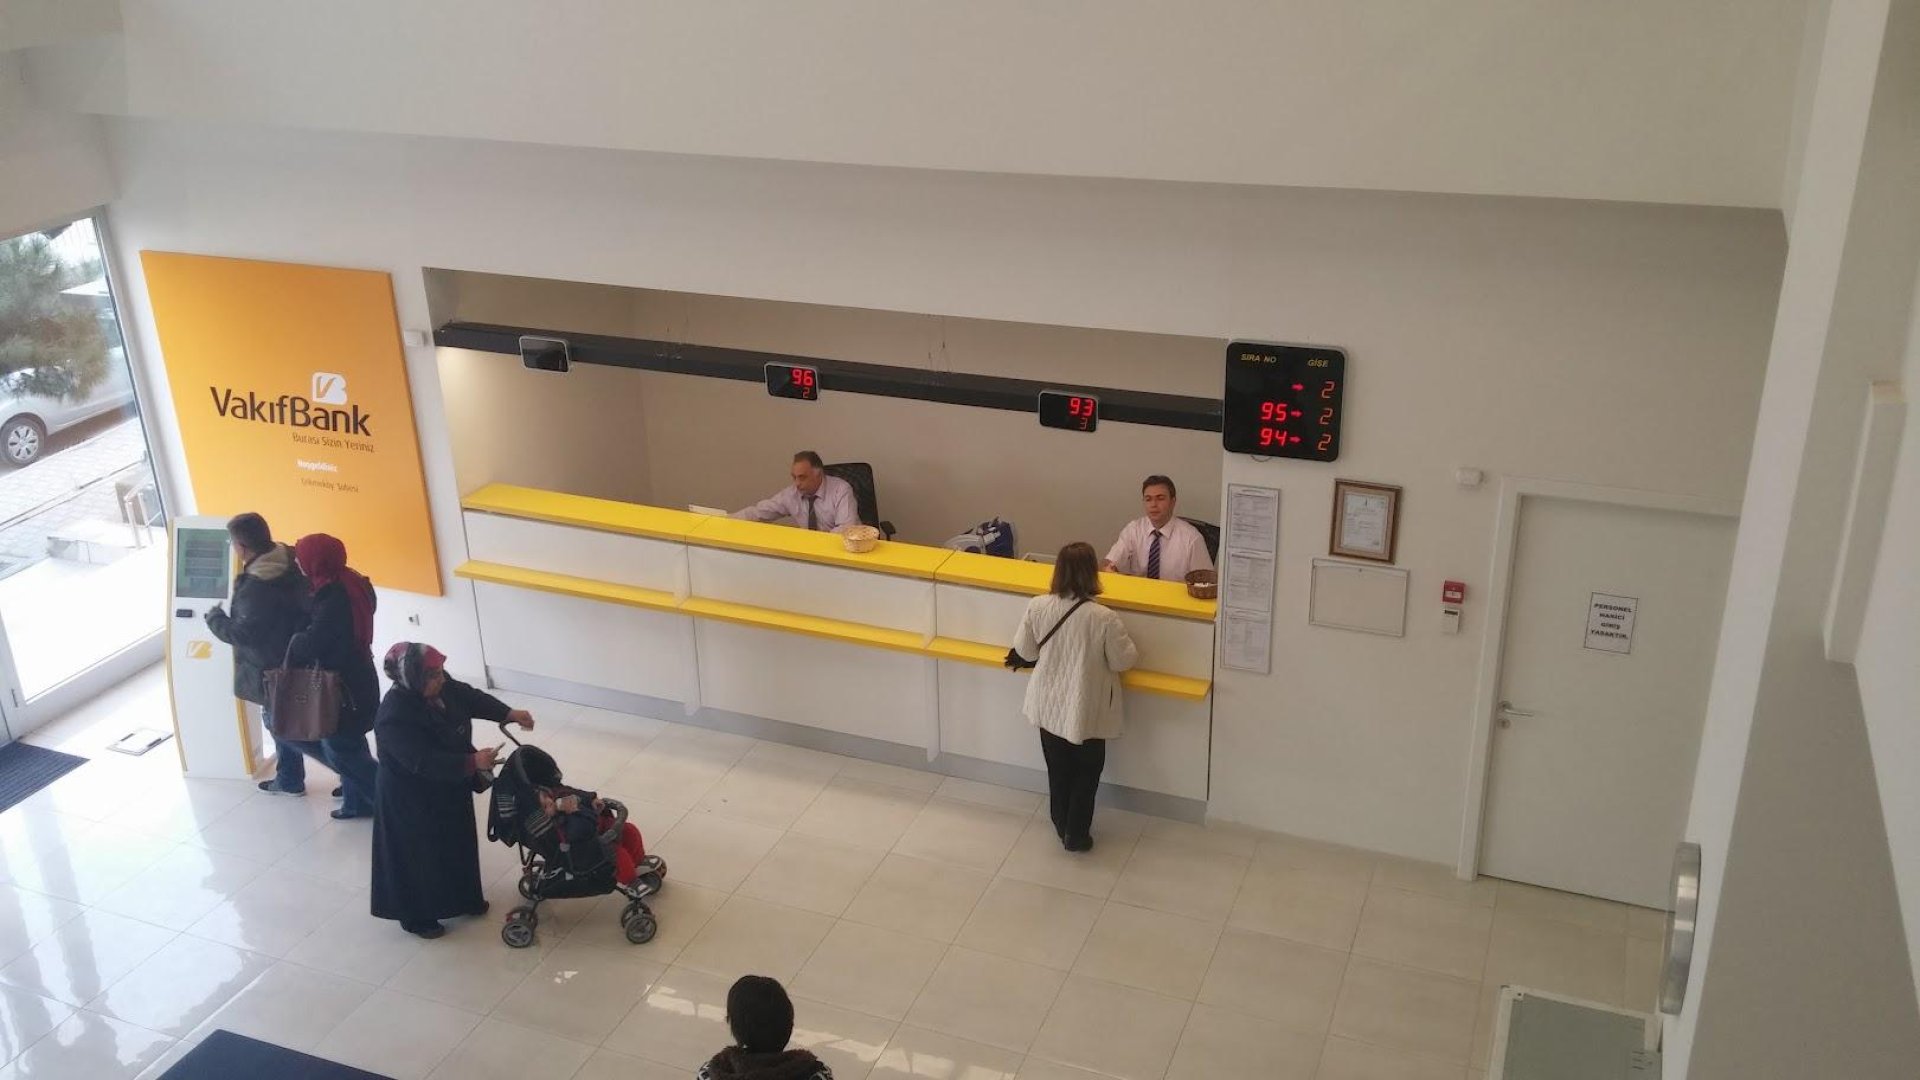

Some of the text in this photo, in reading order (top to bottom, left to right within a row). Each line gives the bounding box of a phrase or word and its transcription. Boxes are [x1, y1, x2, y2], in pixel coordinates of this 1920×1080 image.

[1241, 353, 1261, 362] SIRA
[1263, 355, 1277, 364] NO
[792, 369, 813, 387] 96
[802, 387, 810, 399] 2
[1321, 381, 1335, 399] 2
[210, 386, 371, 436] VakıfBank
[1070, 397, 1093, 417] 93
[1261, 402, 1333, 425] 95 2
[321, 436, 342, 448] Sizin
[345, 440, 374, 453] Yeriniz
[1260, 428, 1332, 451] 94 2
[1594, 603, 1632, 613] PERSONEL
